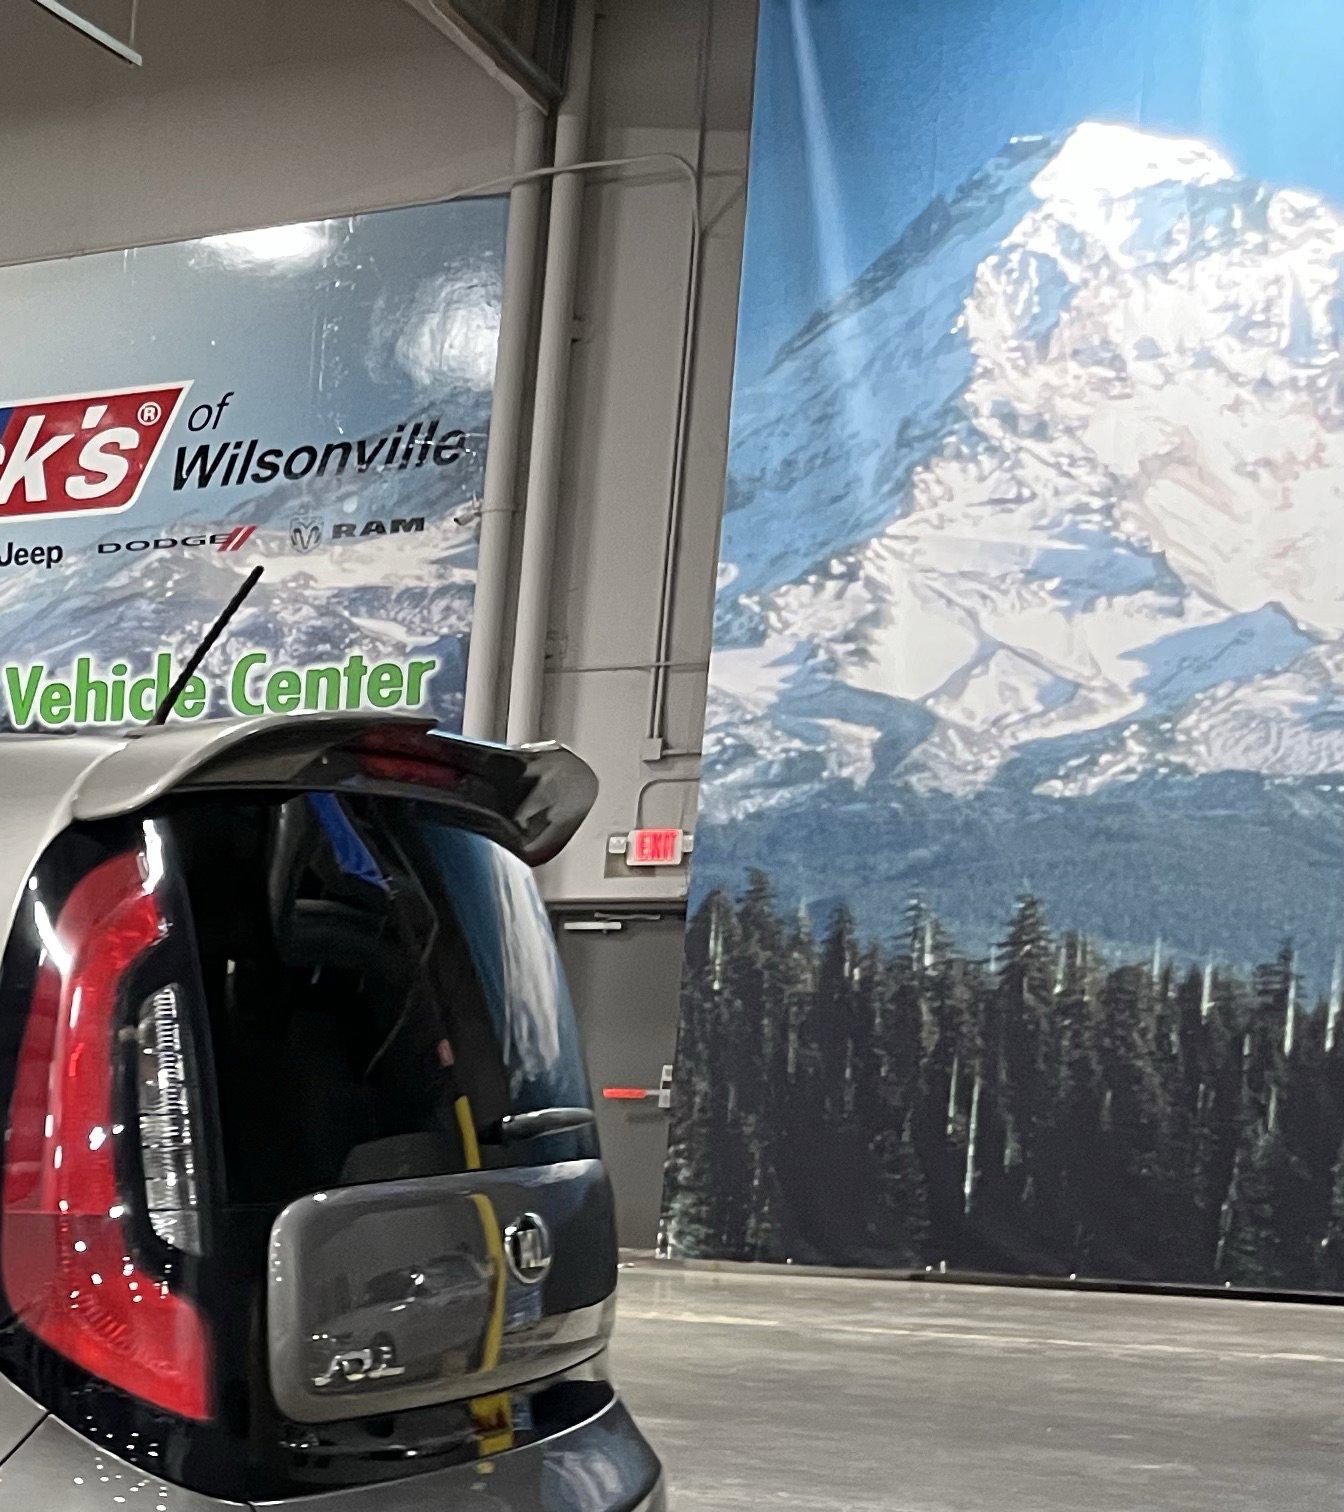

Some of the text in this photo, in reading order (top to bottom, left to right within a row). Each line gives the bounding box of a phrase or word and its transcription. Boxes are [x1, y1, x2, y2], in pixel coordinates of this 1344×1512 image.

[187, 391, 235, 433] of
[171, 420, 466, 491] Wilsonville
[97, 533, 229, 555] DODGE
[331, 516, 426, 540] RAM
[5, 652, 206, 726] Vehicle
[231, 652, 436, 716] Center
[638, 831, 677, 861] EXIT
